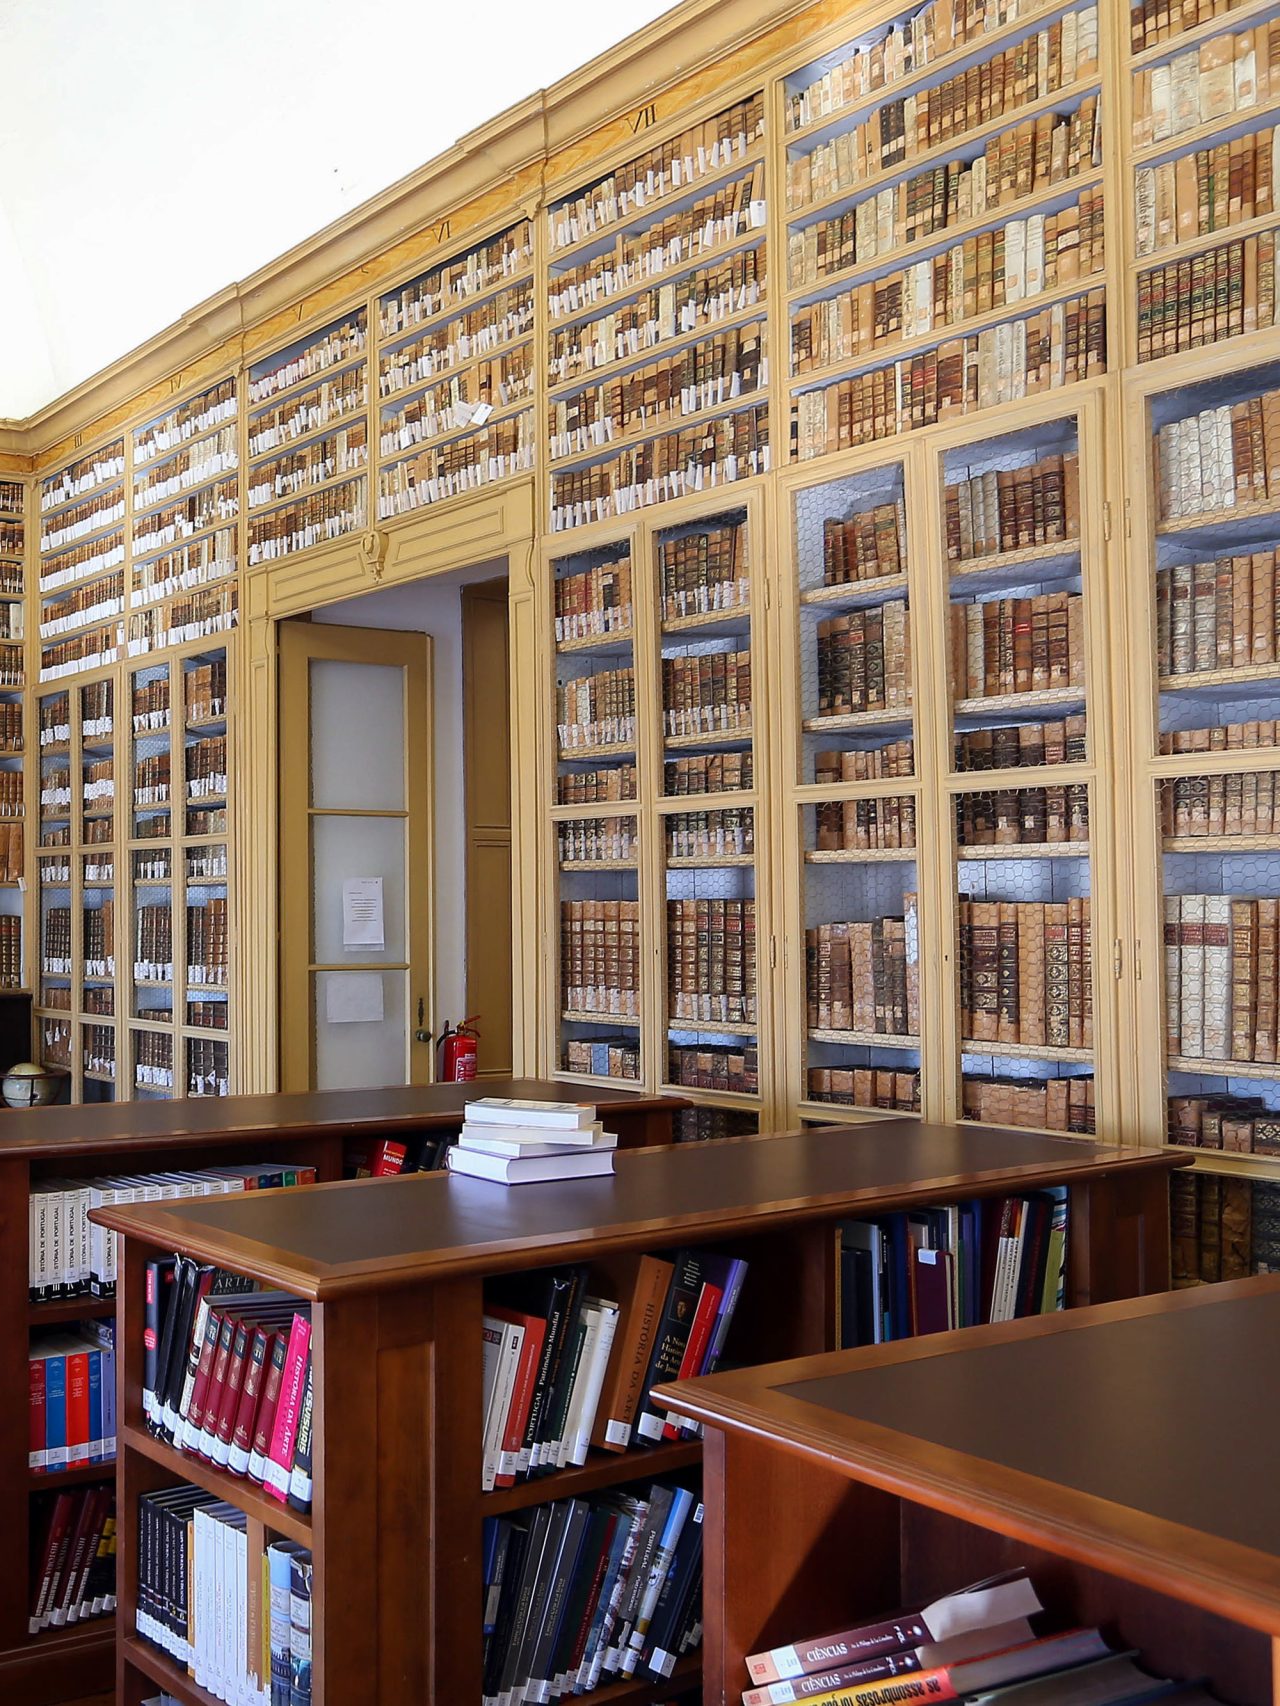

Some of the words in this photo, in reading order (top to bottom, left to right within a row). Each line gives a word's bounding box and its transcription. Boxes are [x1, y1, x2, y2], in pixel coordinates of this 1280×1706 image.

[624, 103, 656, 134] VII
[431, 220, 450, 243] VI
[527, 1391, 543, 1441] PORTUGAL
[549, 1311, 560, 1343] Mundial
[629, 1371, 639, 1389] DA
[287, 1408, 294, 1424] DA
[622, 1394, 635, 1423] ART
[281, 1426, 292, 1457] ARTE
[641, 1530, 656, 1569] PORTUGAL
[806, 1642, 848, 1663] CIÊNCIAS
[800, 1672, 841, 1693] CIÊNCIAS
[856, 1680, 923, 1706] assombrosas
[926, 1675, 941, 1693] as
